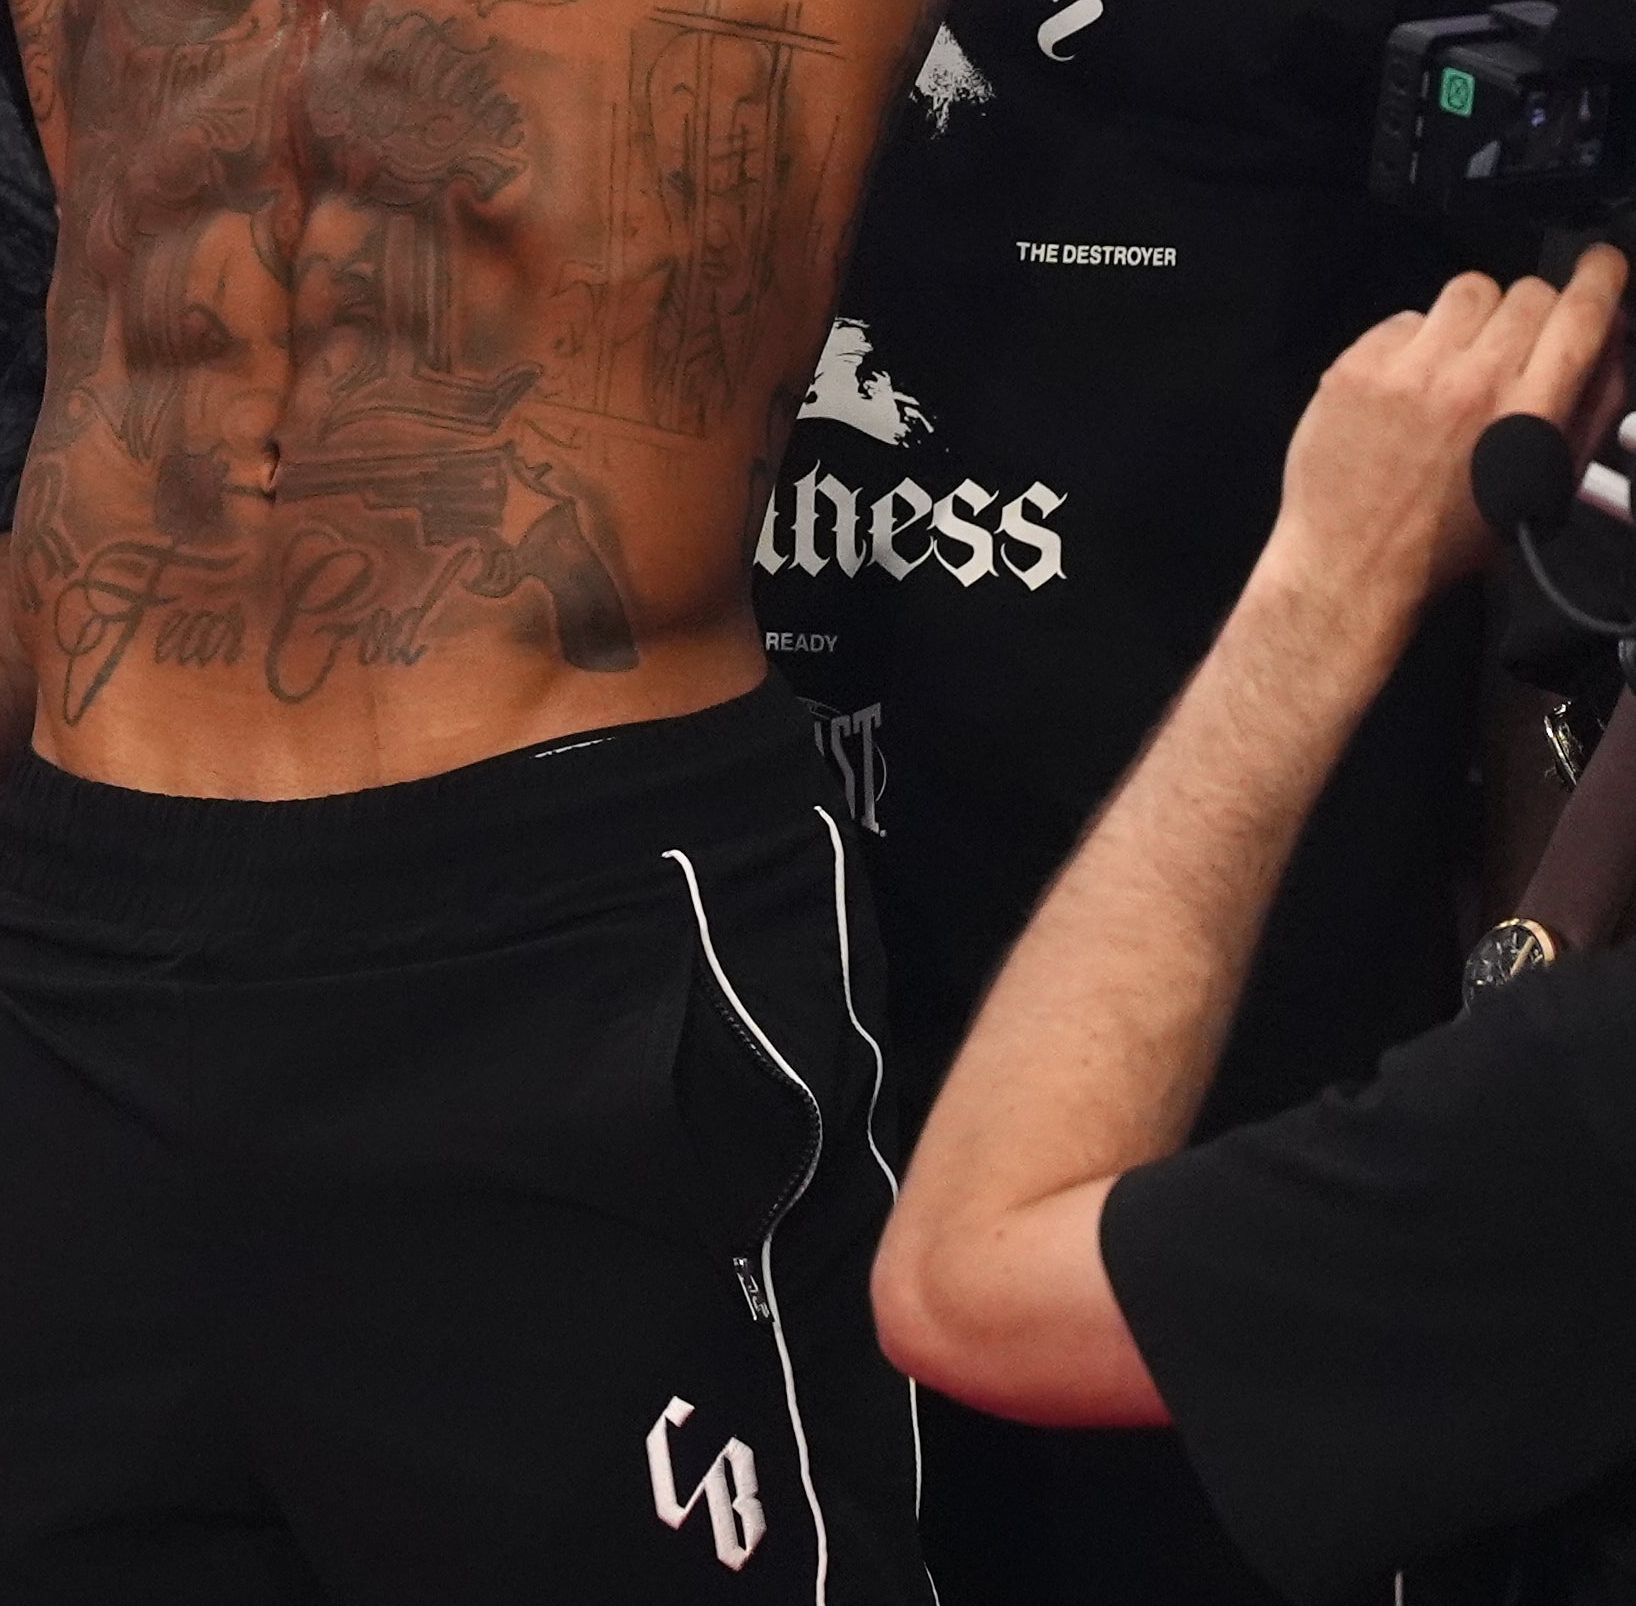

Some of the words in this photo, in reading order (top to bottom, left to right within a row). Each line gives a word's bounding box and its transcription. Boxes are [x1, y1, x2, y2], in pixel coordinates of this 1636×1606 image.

[1016, 242, 1060, 264] THE
[1062, 245, 1177, 267] DESTROYER
[55, 541, 244, 726] Fear
[765, 631, 838, 652] READY
